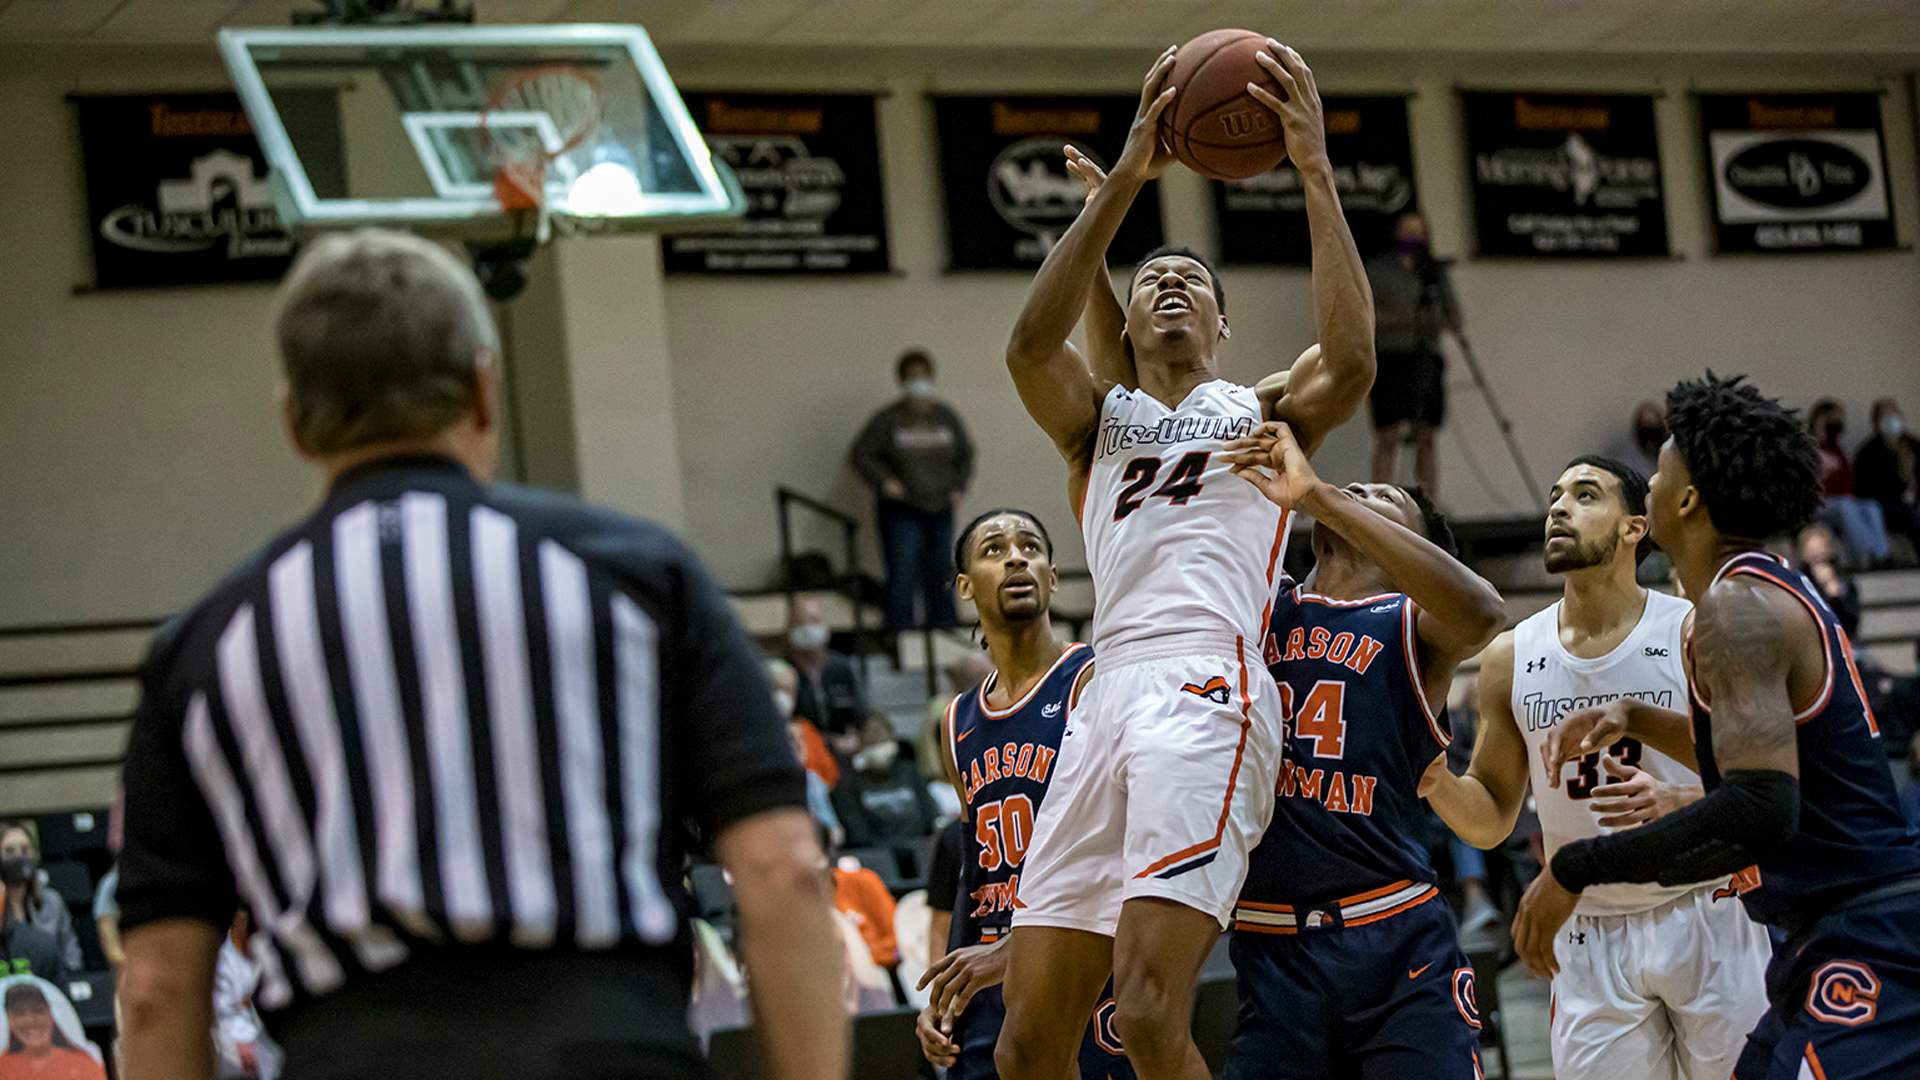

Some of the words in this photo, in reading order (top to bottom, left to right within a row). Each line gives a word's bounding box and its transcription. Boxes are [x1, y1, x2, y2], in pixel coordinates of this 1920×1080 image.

[1099, 416, 1252, 459] TUSCULUM
[1113, 451, 1212, 522] 24
[1262, 626, 1384, 675] ARSON
[1644, 647, 1669, 658] SAC
[1275, 758, 1377, 816] WMAN
[976, 793, 1035, 872] 50
